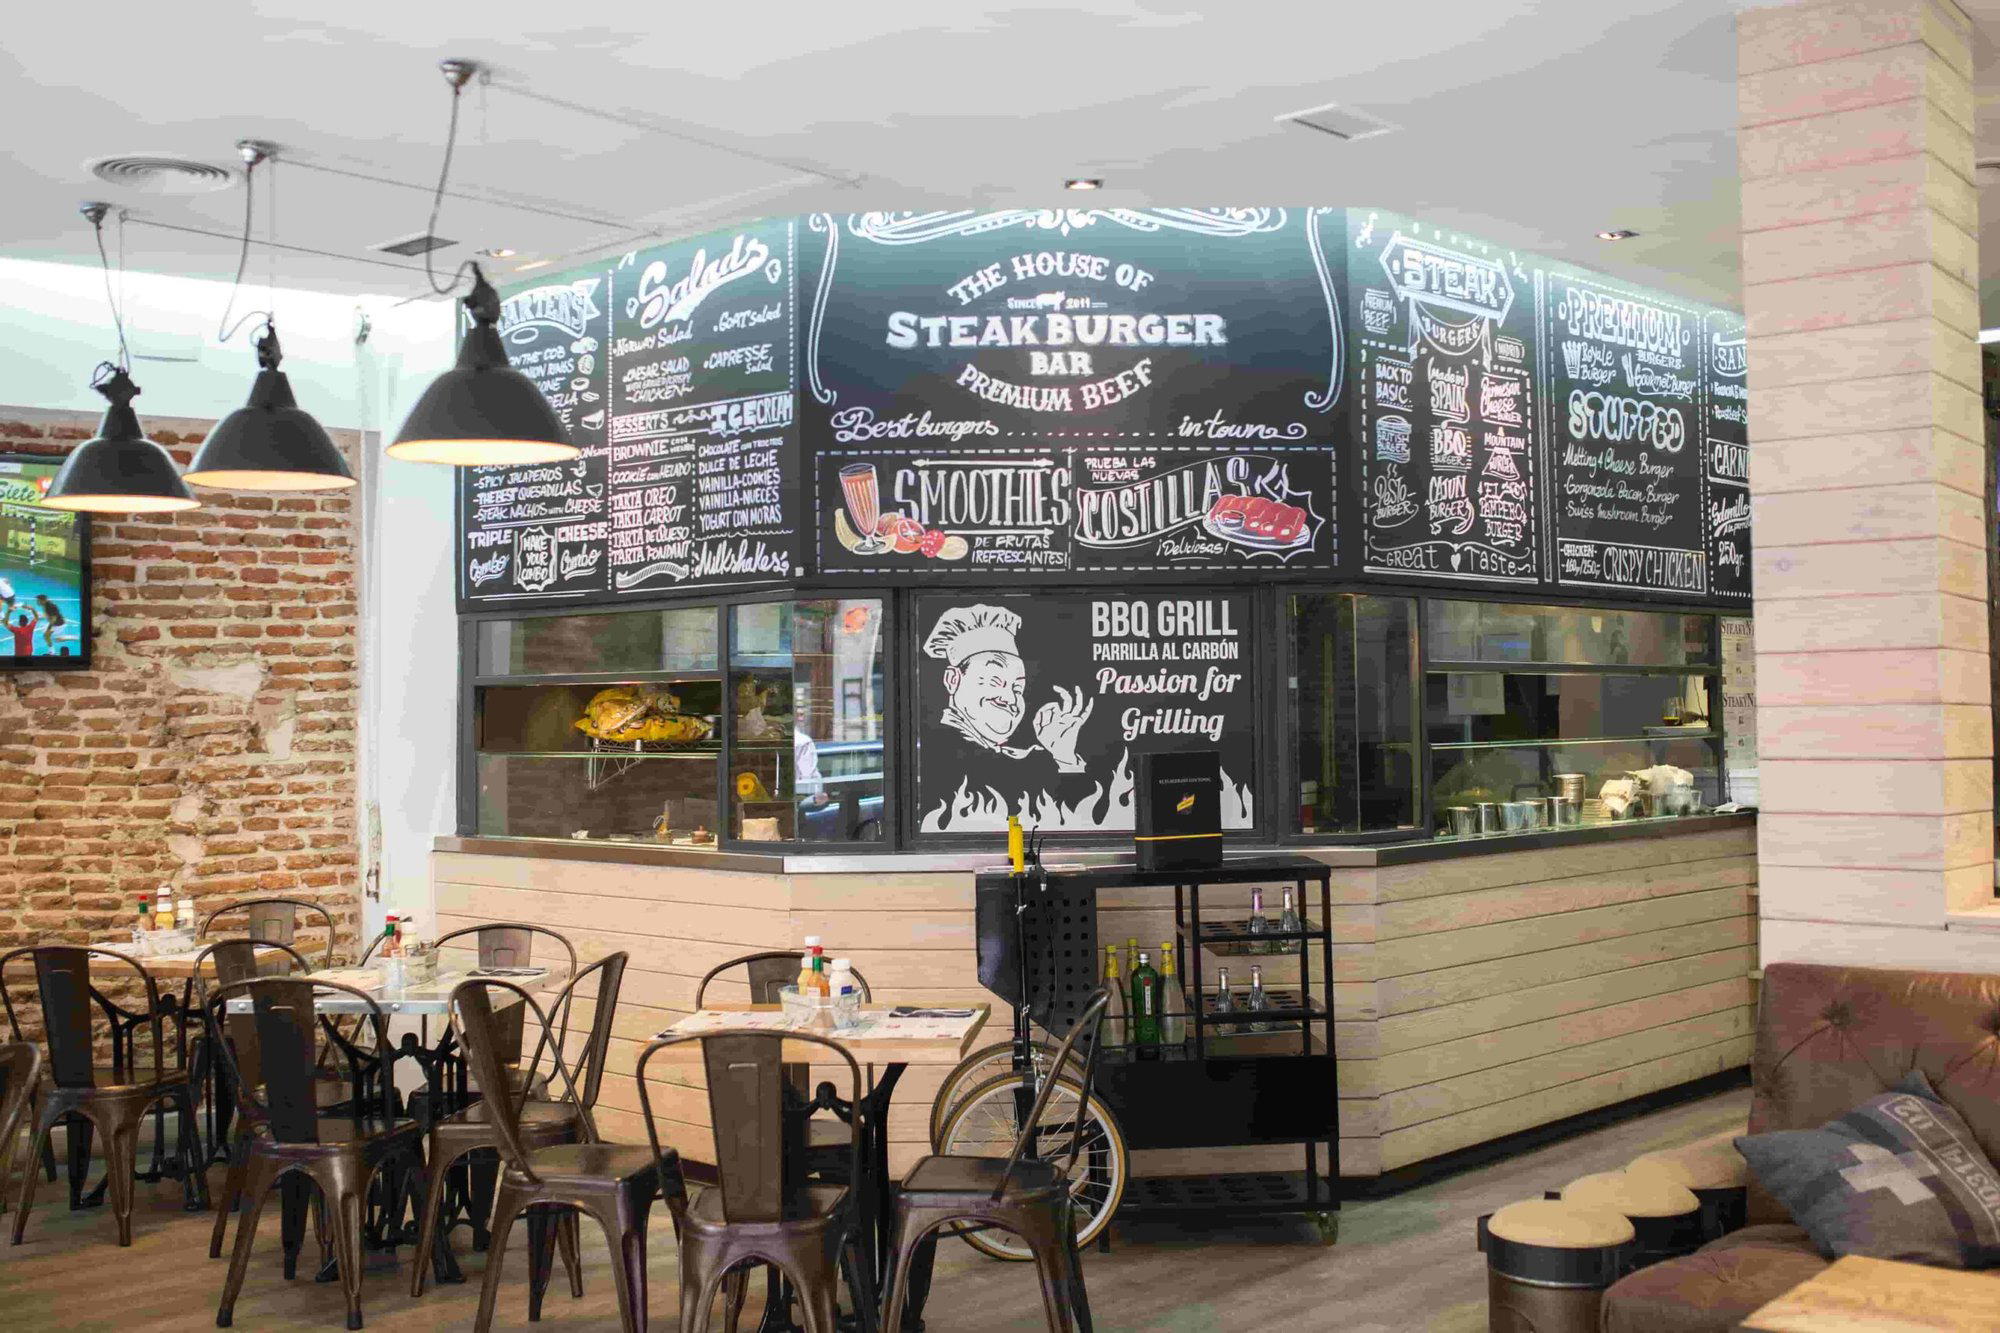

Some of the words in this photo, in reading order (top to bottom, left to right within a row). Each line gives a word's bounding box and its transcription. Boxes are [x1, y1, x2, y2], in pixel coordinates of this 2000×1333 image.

[638, 234, 769, 329] Salads
[947, 262, 1008, 306] THE
[1010, 251, 1111, 282] HOUSE
[1114, 263, 1155, 293] OF
[1403, 249, 1498, 308] STEAK
[501, 288, 585, 333] ARTERS
[750, 302, 782, 327] Salad
[658, 321, 694, 348] Salad
[885, 311, 1041, 349] STEAK
[1045, 312, 1229, 348] BURGER
[660, 356, 690, 377] SALAD
[745, 357, 773, 374] Salad
[1029, 351, 1094, 376] BAR
[1376, 363, 1398, 382] BACK
[1400, 368, 1413, 384] TO
[956, 363, 1073, 413] PREMIUM
[1079, 357, 1153, 411] BEEF
[1431, 381, 1466, 412] SPAIN
[612, 412, 669, 435] DESSERTS
[831, 406, 918, 442] Best
[915, 410, 1000, 442] burgers
[1178, 415, 1205, 438] in
[1203, 408, 1275, 440] town
[613, 439, 670, 462] BROWNIE
[1433, 428, 1469, 456] BBQ
[1484, 432, 1525, 450] MOUNTAIN
[699, 458, 725, 475] DULCE
[729, 456, 740, 470] DE
[744, 450, 778, 467] LECHE
[1084, 457, 1128, 470] PRUEBA
[1132, 456, 1157, 469] LAS
[1434, 455, 1466, 467] BURGER
[1604, 448, 1637, 475] Cheese
[1639, 452, 1674, 485] Burger
[613, 468, 650, 485] COOKIE
[1091, 470, 1140, 481] NUEVAS
[612, 490, 643, 511] TARTA
[645, 486, 677, 505] OREO
[894, 467, 1070, 527] SMOOTHIES
[1082, 456, 1251, 542] COSTILLAS
[1428, 474, 1468, 504] CAJUN
[1616, 480, 1646, 503] Bacon
[1647, 484, 1680, 514] Burger
[510, 503, 547, 519] NACHOS
[564, 498, 603, 514] CHEESE
[612, 509, 643, 529] TARTA
[644, 505, 686, 524] CARROT
[733, 510, 749, 528] CON
[750, 504, 782, 525] MORAS
[1376, 501, 1415, 519] BURGER
[1429, 500, 1468, 520] BURGER
[1567, 501, 1594, 519] Swiss
[1641, 505, 1674, 530] Burger
[468, 529, 513, 549] TRIPLE
[523, 535, 548, 551] MAKE
[557, 522, 609, 543] CHEESE
[612, 528, 643, 548] TARTA
[656, 525, 690, 542] QUESO
[974, 536, 993, 548] DE
[995, 535, 1051, 549] FRUTAS
[1484, 520, 1523, 541] BURGER
[469, 552, 511, 582] Combo
[525, 553, 549, 566] YOUR
[559, 543, 602, 574] Combo
[612, 547, 645, 565] TARTA
[695, 539, 786, 577] Milkshakes
[1464, 546, 1517, 575] Taste
[1602, 546, 1643, 584] CRISPY
[1645, 551, 1703, 589] CHICKEN
[521, 568, 548, 581] COMBO
[1092, 600, 1150, 639] BBQ
[1157, 600, 1238, 637] GRILL
[1093, 643, 1158, 661] PARRILLA
[1162, 643, 1180, 660] AL
[1182, 638, 1239, 660] CARBÓN
[1096, 667, 1197, 694] Passion
[1198, 666, 1241, 701] for
[1121, 707, 1224, 742] Grilling
